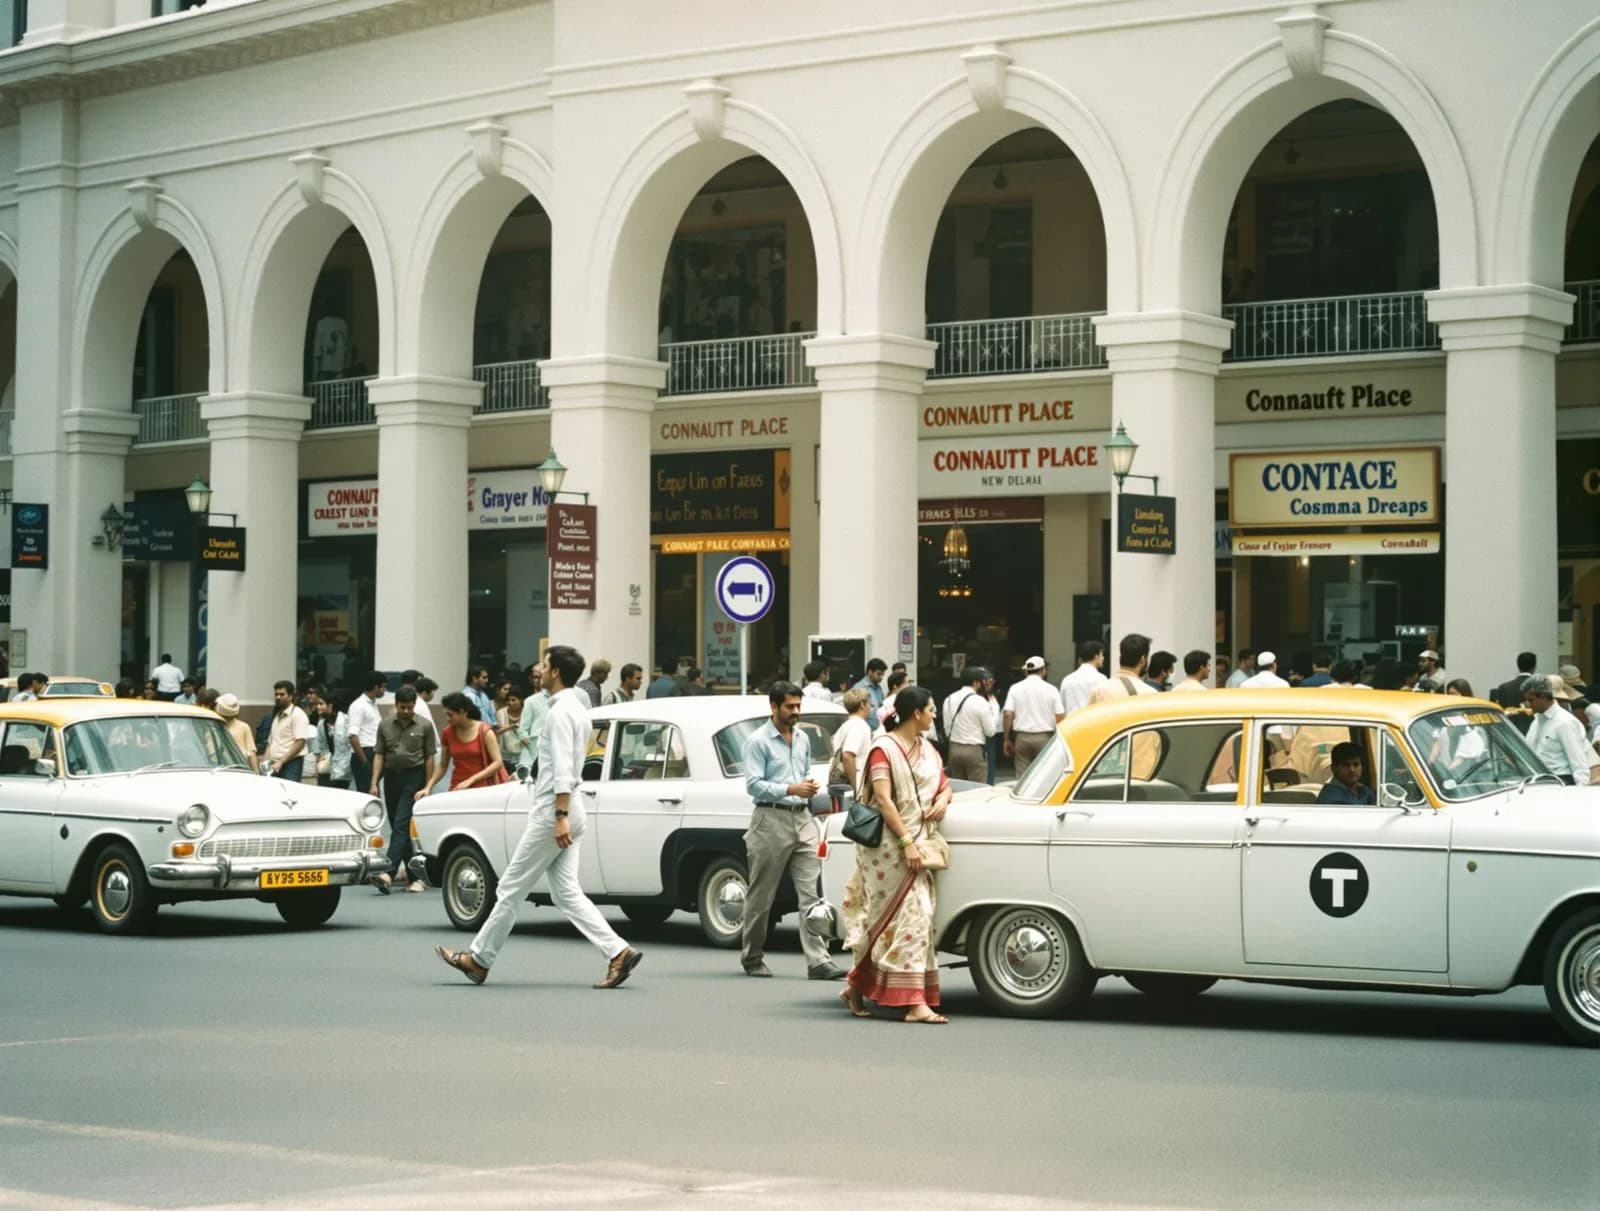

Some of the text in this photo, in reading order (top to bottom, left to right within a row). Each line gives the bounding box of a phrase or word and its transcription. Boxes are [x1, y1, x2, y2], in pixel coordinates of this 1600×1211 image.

[1351, 383, 1413, 408] Place
[923, 400, 1074, 427] CONNAUTT PLACE
[661, 416, 789, 440] CONNAUTT PLACE
[933, 446, 1098, 472] CONNAUTT PLACE
[981, 476, 1004, 487] NEW
[1262, 460, 1398, 492] CONTACE
[482, 487, 528, 512] Grayer
[1367, 496, 1429, 517] Dreaps
[1321, 868, 1358, 908] T
